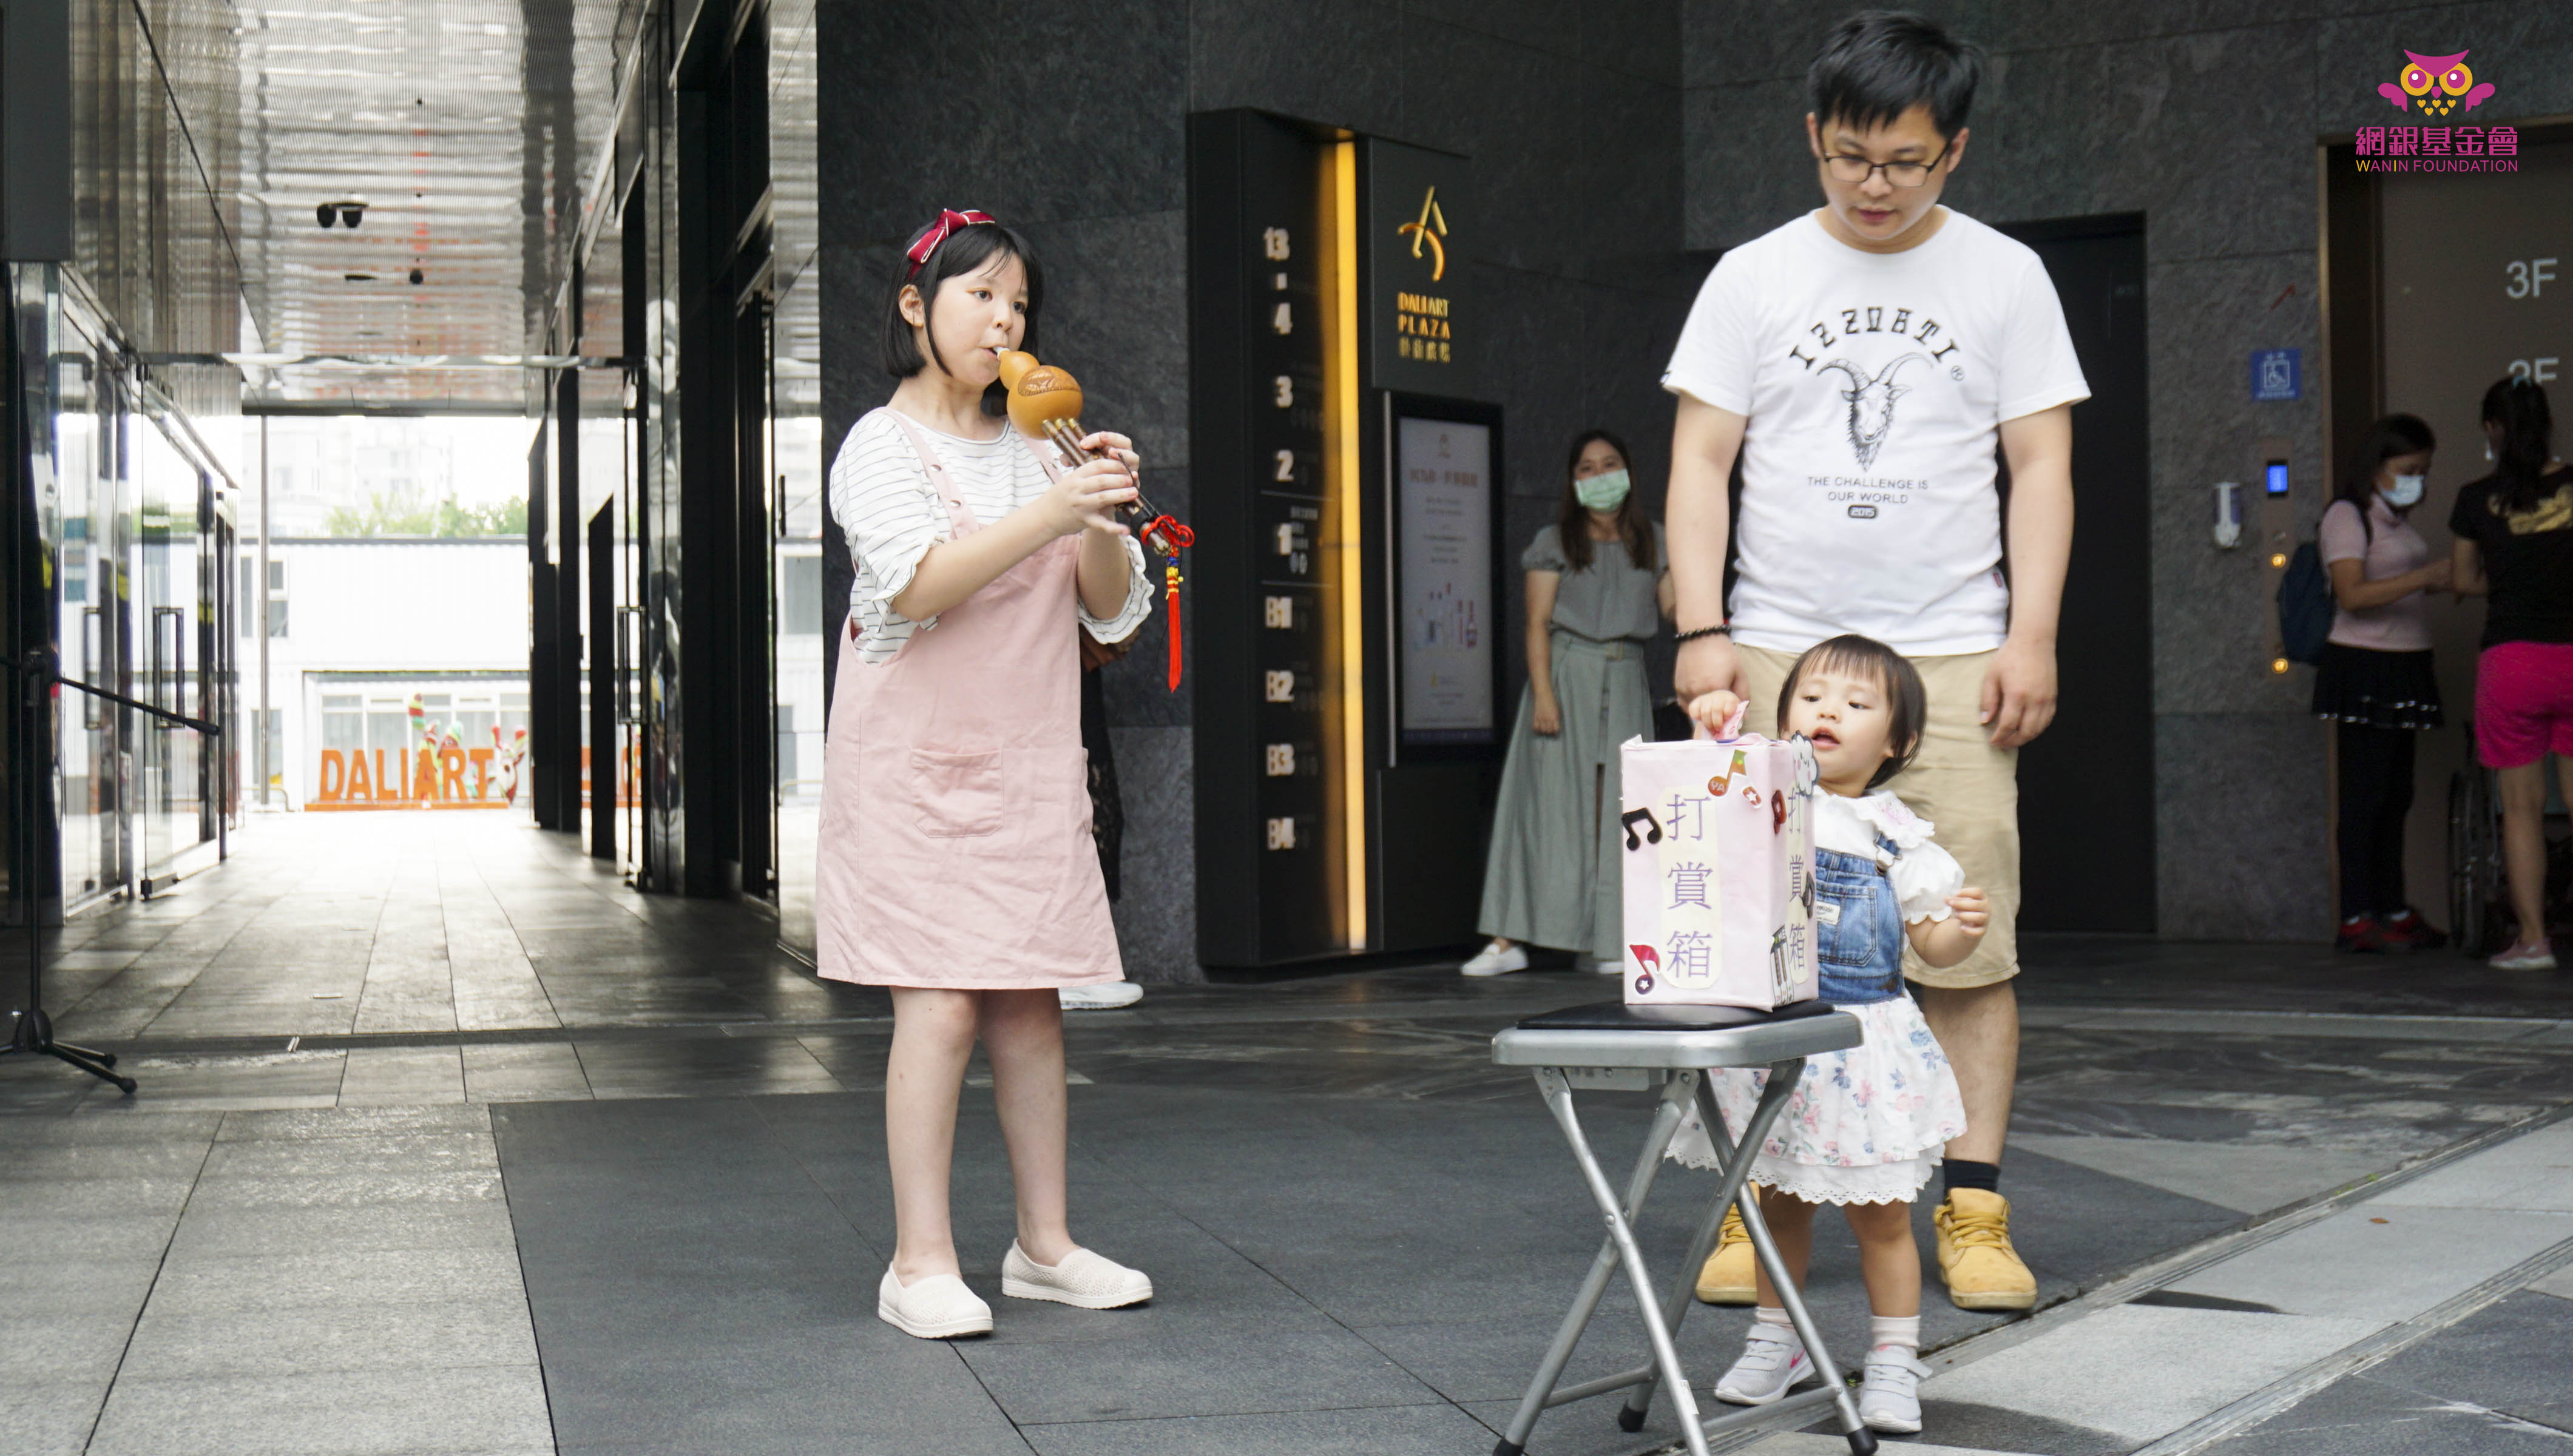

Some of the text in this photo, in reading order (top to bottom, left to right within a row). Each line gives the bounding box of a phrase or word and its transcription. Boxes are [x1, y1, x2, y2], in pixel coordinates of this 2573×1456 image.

[1263, 226, 1290, 261] 13
[2506, 258, 2558, 299] 3F
[1275, 302, 1293, 335] 4
[1398, 292, 1449, 317] DALIART
[1398, 314, 1451, 339] PLAZA
[1276, 375, 1293, 408] 3
[1276, 449, 1294, 482] 2
[1807, 476, 1929, 490] THE CHALLENGE IS
[1828, 491, 1909, 504] OUR WORLD
[1277, 522, 1293, 555] 1
[1265, 596, 1293, 629] B1
[1265, 670, 1296, 703] B2
[319, 748, 493, 800] DALIART
[1266, 743, 1296, 777] B3
[1666, 794, 1714, 979] 打賞箱
